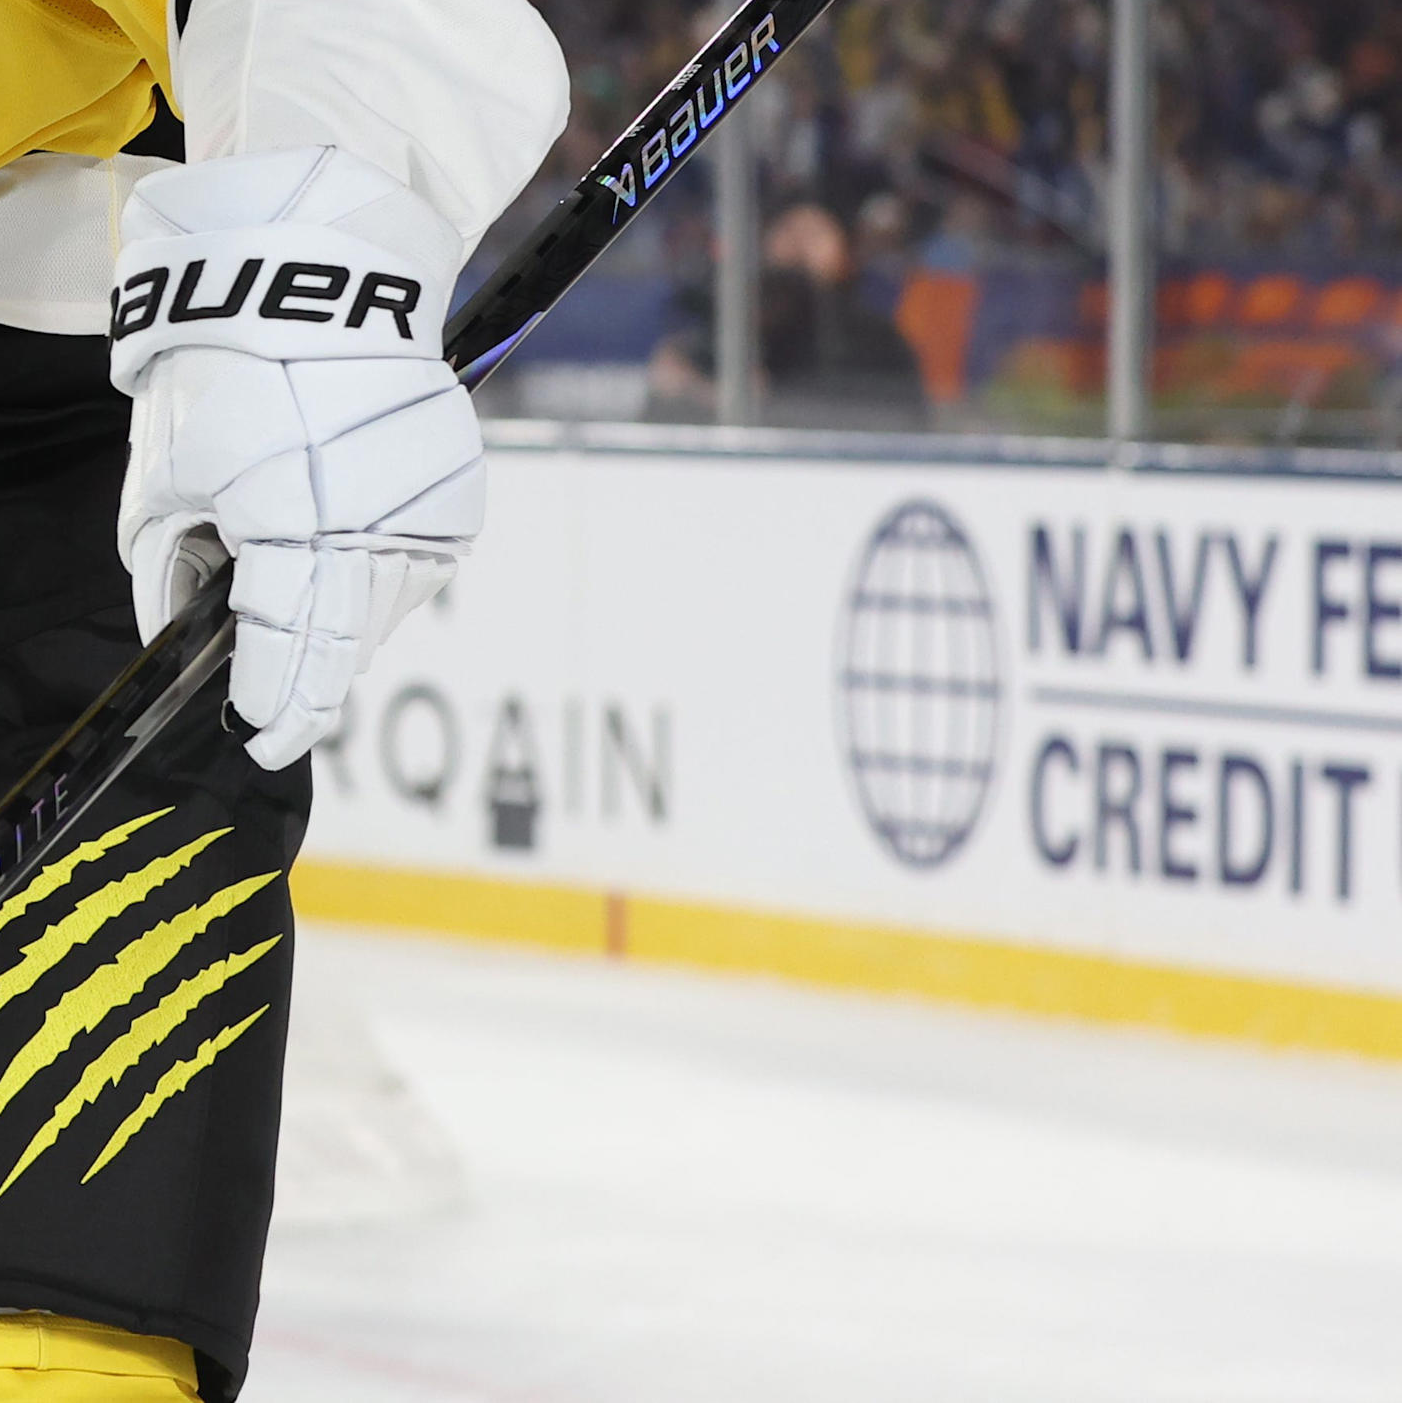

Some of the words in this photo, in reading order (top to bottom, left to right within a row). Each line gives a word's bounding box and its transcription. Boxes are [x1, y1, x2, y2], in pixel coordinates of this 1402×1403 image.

[110, 257, 422, 342] AUER
[1026, 520, 1280, 674] NAVY
[1028, 730, 1374, 908] CREDIT
